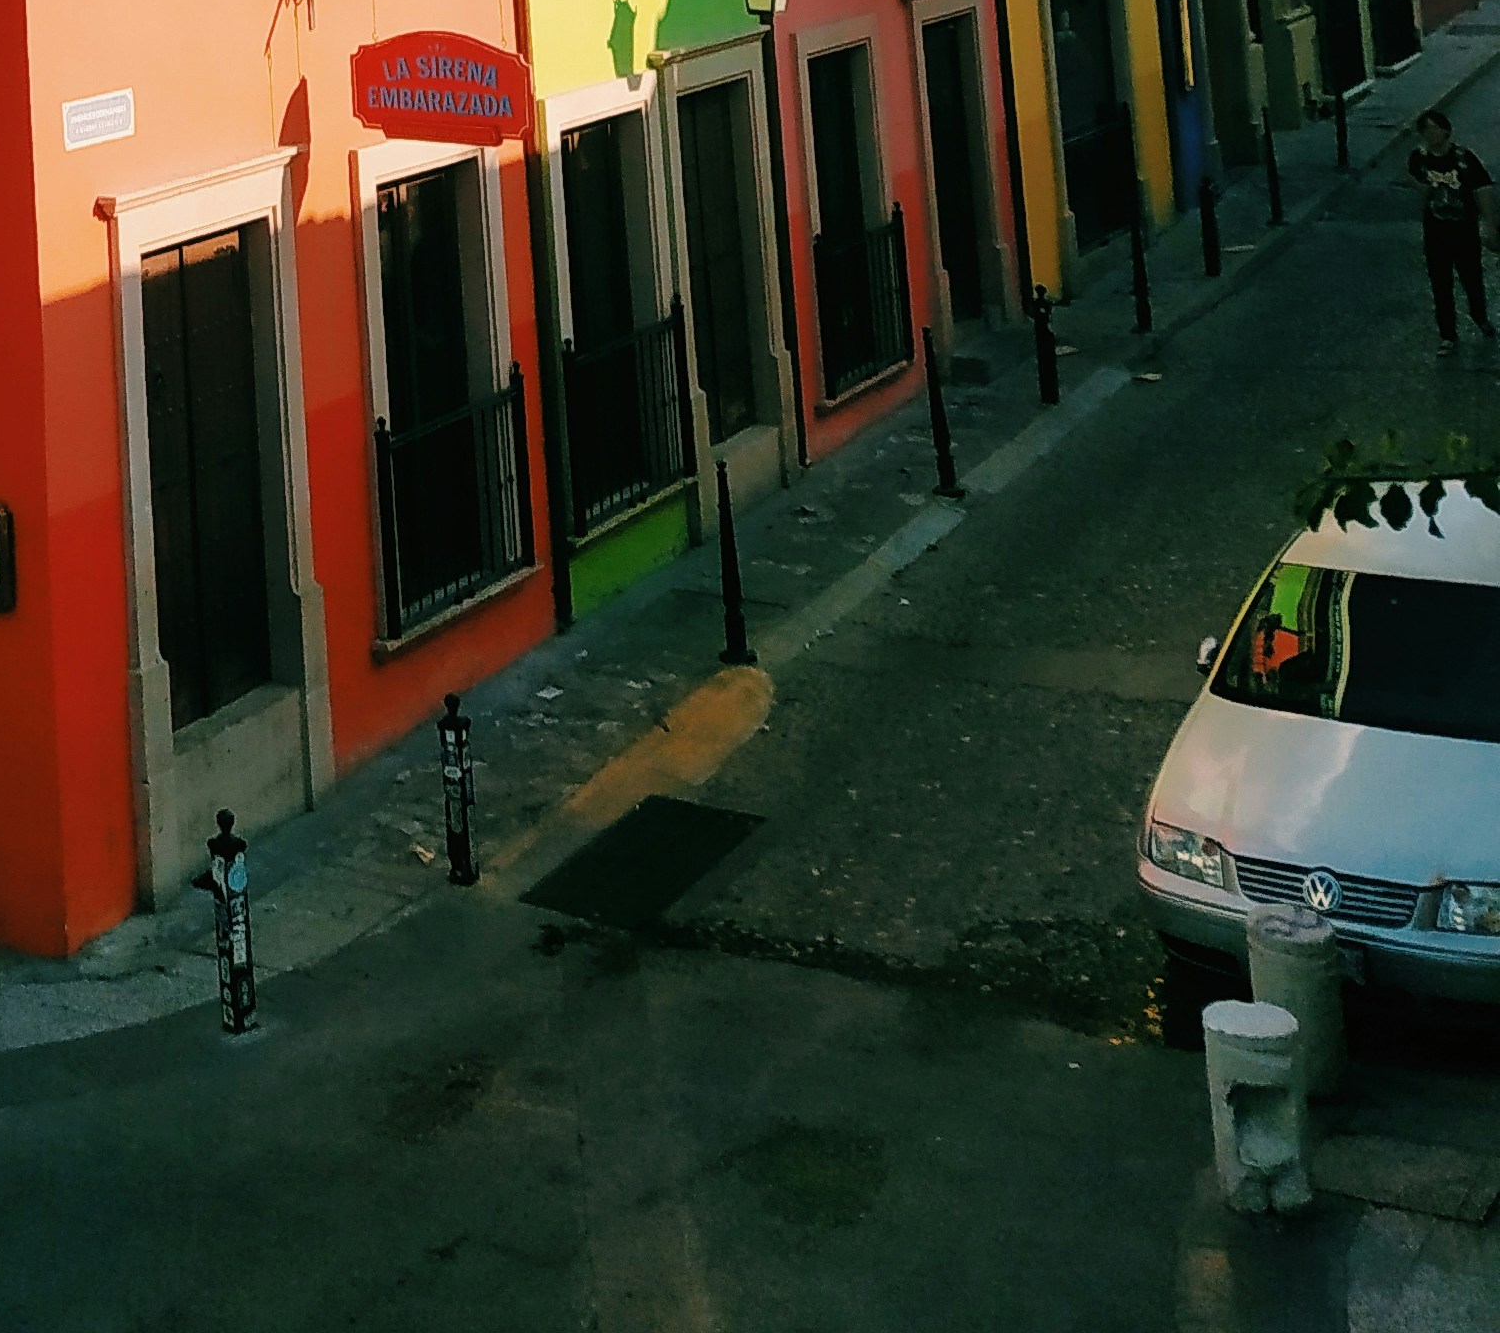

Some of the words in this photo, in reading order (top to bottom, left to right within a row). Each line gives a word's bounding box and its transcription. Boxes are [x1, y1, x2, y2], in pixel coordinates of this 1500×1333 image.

[382, 57, 412, 82] LA
[416, 53, 498, 90] SIRENA
[368, 85, 513, 118] EMBARAZADA
